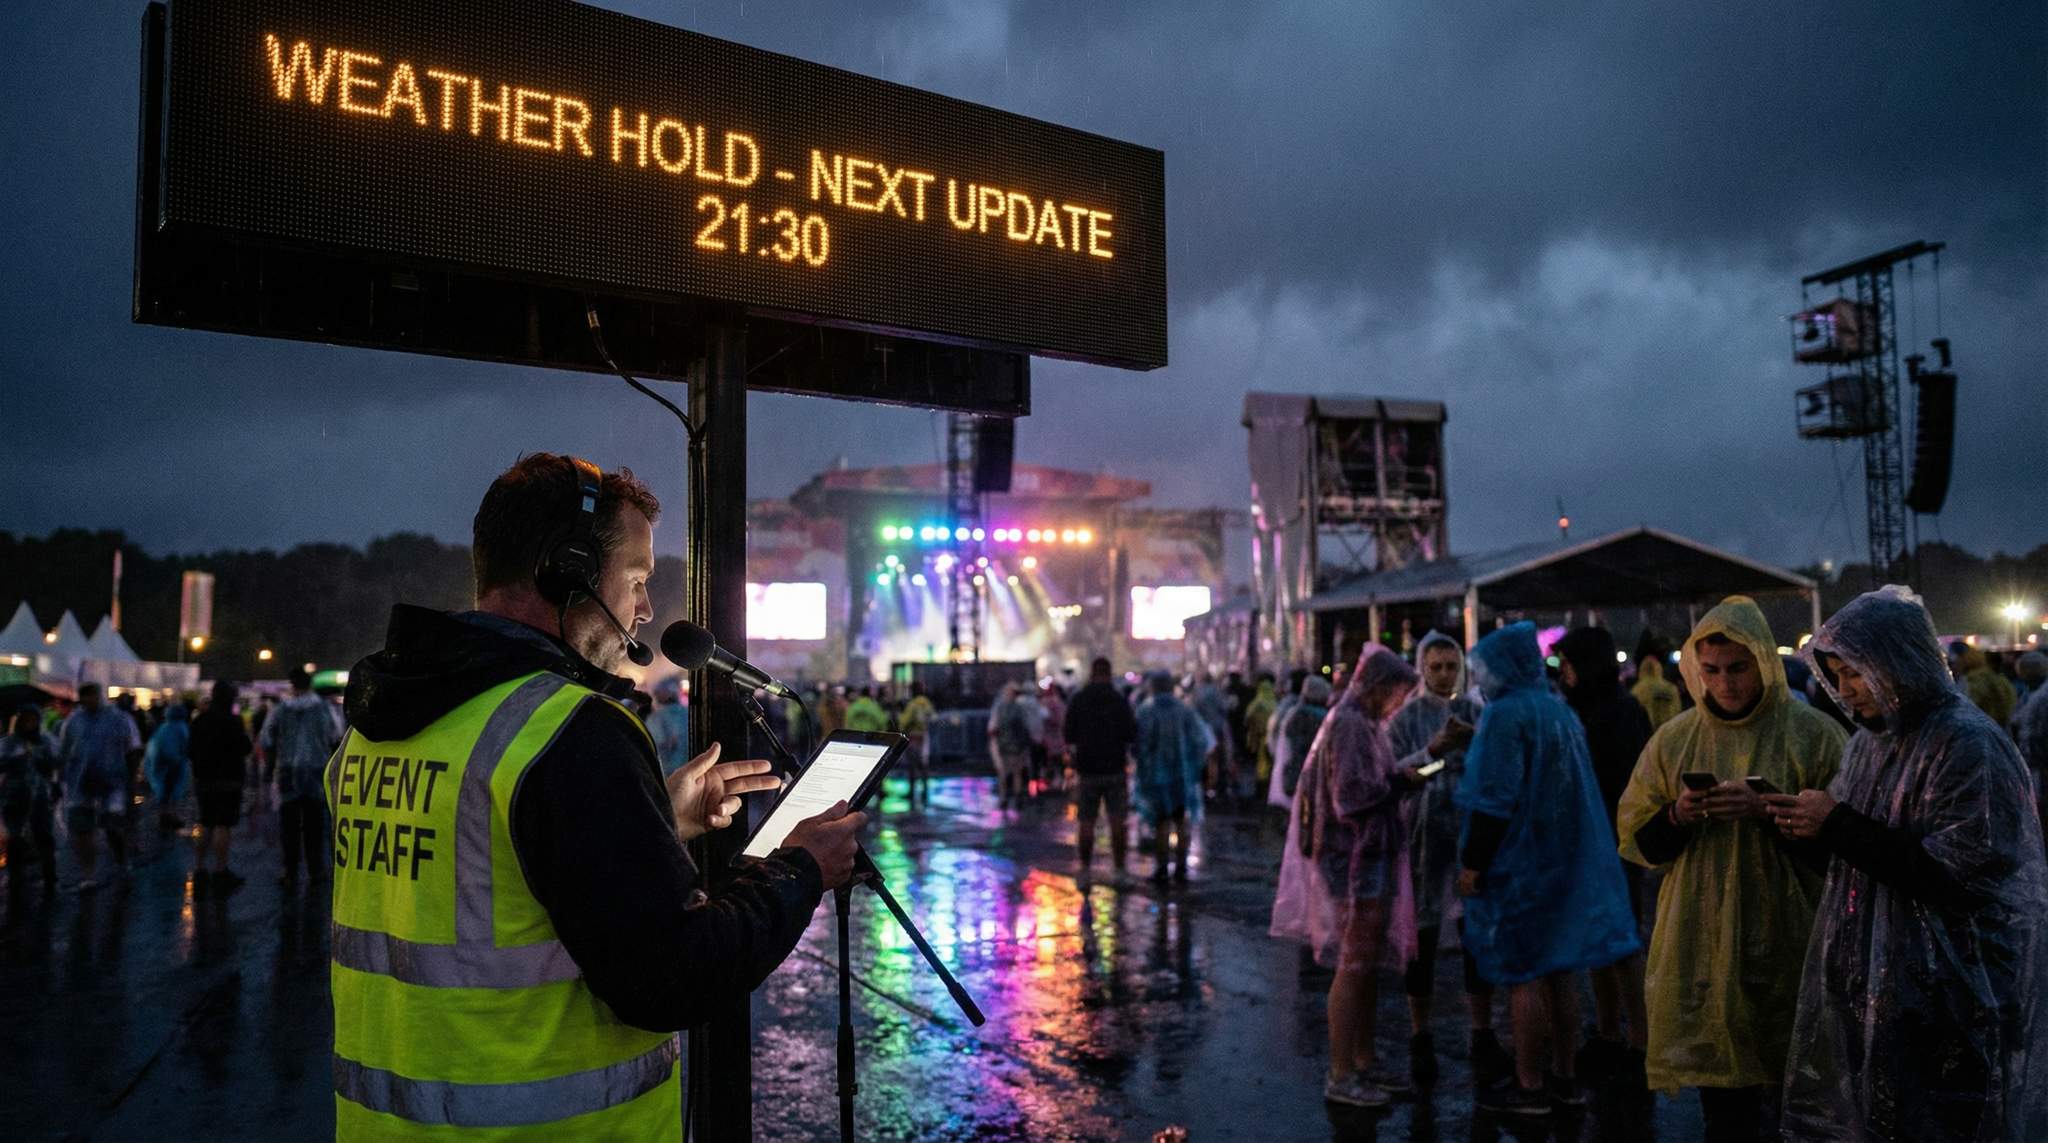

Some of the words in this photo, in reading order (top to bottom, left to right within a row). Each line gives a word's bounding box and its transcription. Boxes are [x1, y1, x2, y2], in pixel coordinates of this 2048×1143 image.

[264, 33, 593, 158] WEATHER
[609, 106, 762, 188] HOLD
[807, 148, 937, 222] NEXT
[943, 178, 1115, 260] UPDATE
[694, 194, 832, 269] 21:30
[340, 755, 449, 814] EVENT
[336, 817, 436, 881] STAFF
